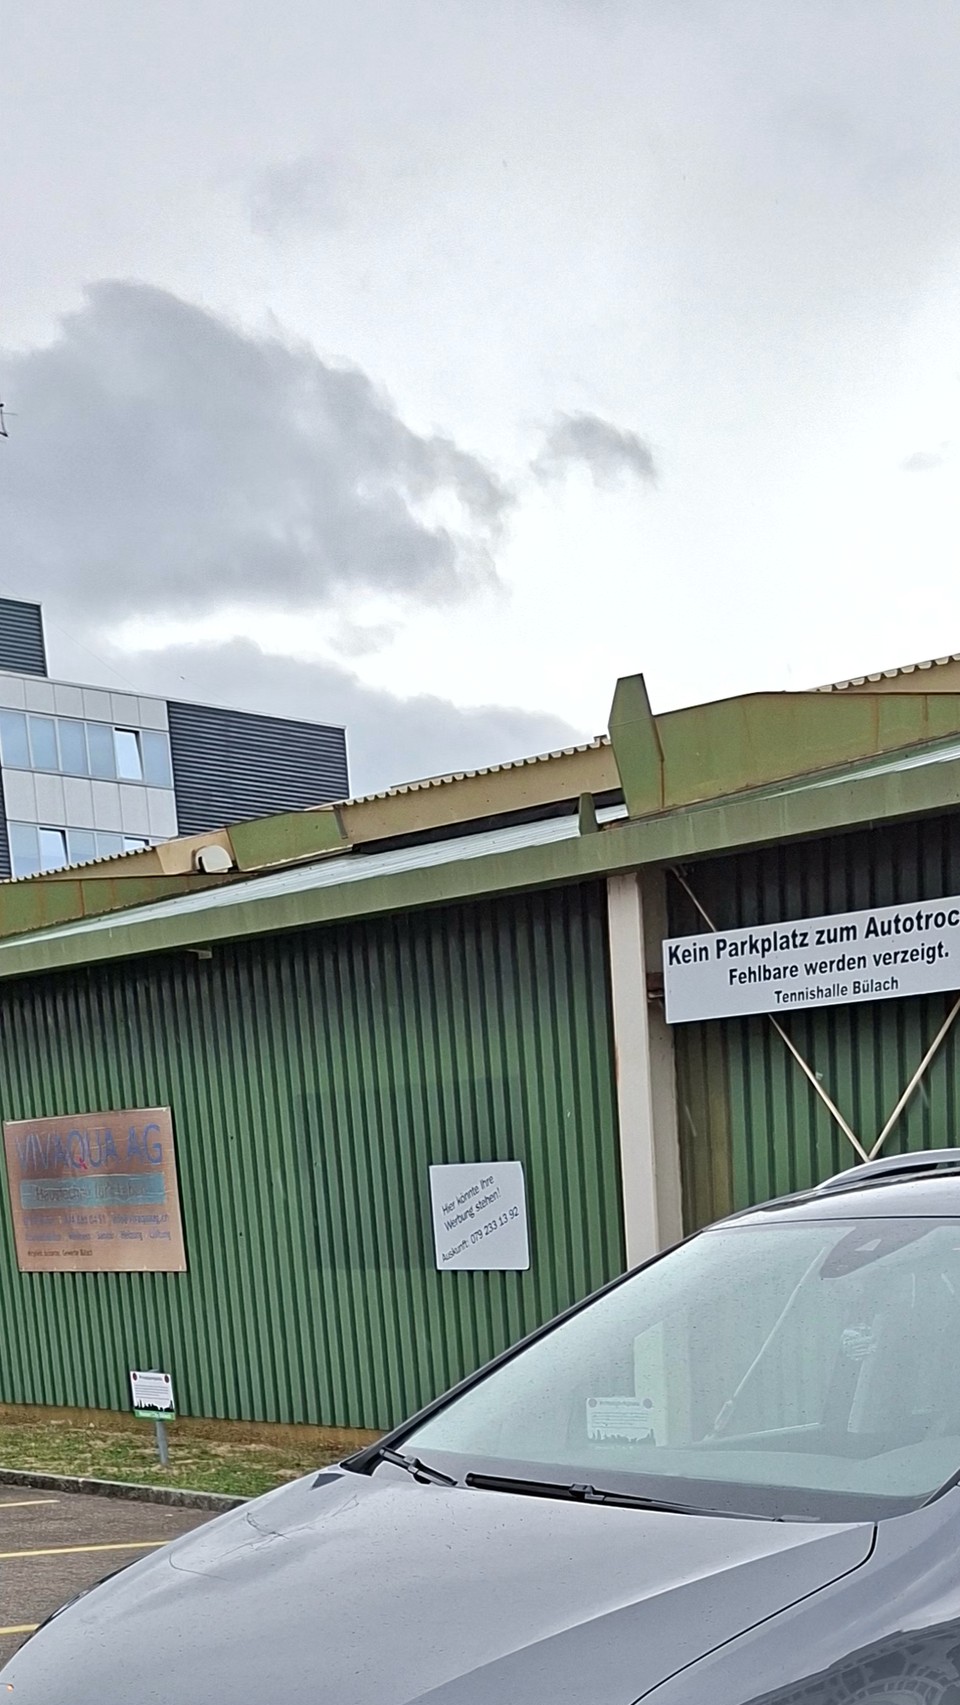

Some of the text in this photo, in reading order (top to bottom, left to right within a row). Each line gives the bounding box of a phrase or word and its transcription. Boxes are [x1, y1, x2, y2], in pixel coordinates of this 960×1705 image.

[668, 942, 709, 966] Kein
[716, 929, 809, 963] Parkplatz
[815, 921, 857, 946] zum
[729, 940, 949, 986] Fehlbare werden verzeigt.
[774, 977, 899, 1004] Tennishalle Bülach
[127, 1123, 163, 1166] AG
[441, 1175, 495, 1216] Hier könnte Ihre
[444, 1187, 501, 1231] Werbung stehen!
[470, 1229, 483, 1244] 079
[484, 1220, 498, 1236] 233
[498, 1213, 509, 1227] 13
[509, 1206, 519, 1219] 92
